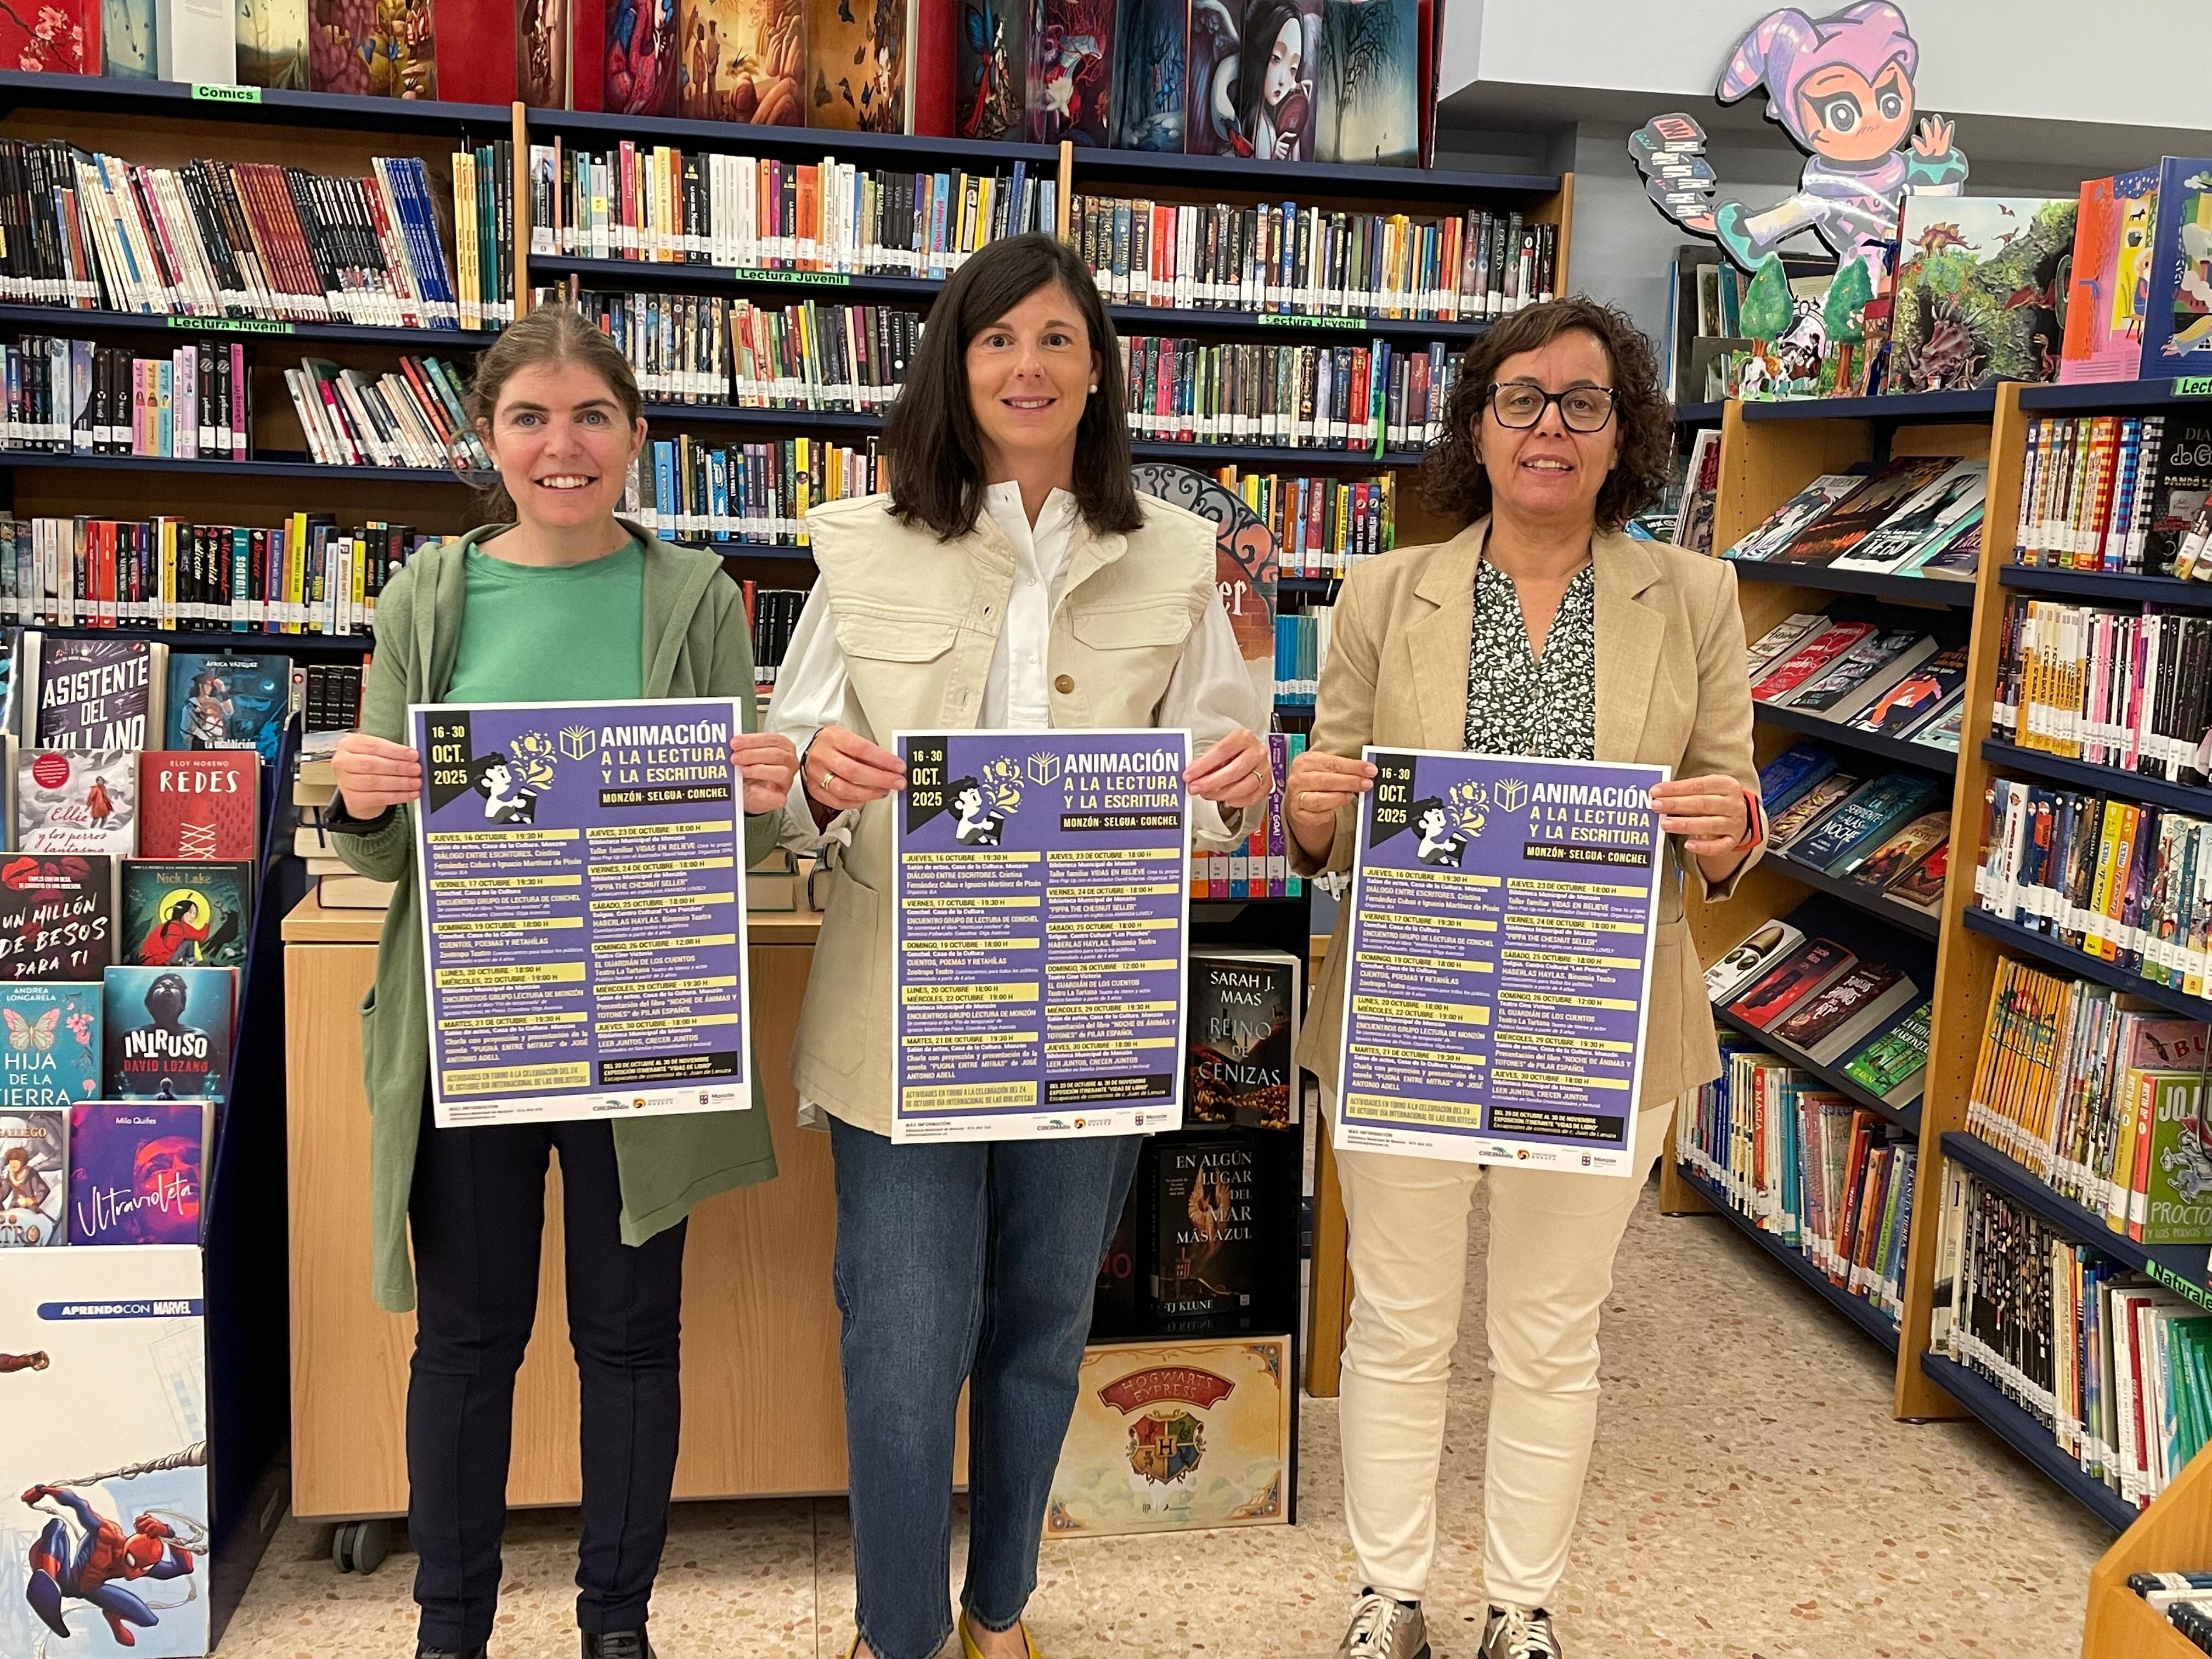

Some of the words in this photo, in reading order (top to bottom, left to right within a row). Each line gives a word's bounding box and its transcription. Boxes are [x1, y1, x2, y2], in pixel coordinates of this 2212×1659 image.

[199, 87, 253, 100] Comics
[741, 269, 792, 281] Lectura
[797, 273, 844, 284] Juvenil
[174, 318, 230, 329] Lectura
[234, 320, 286, 332] Juvenil
[42, 655, 148, 709] ASISTENTE
[81, 698, 108, 726] DEL
[600, 719, 727, 747] ANIMACIÓN
[432, 744, 465, 763] OCT.
[601, 751, 612, 765] A
[619, 750, 641, 765] LA
[648, 747, 725, 764] LECTURA
[1064, 748, 1179, 773] ANIMACIÓN
[160, 770, 240, 794] REDES
[434, 770, 467, 785] 2025
[601, 770, 612, 783] Y
[620, 769, 639, 783] LA
[647, 765, 728, 782] ESCRITURA
[913, 768, 941, 785] OCT.
[1064, 777, 1074, 791] A
[1080, 776, 1100, 791] LA
[1107, 776, 1178, 791] LECTURA
[687, 788, 729, 799] CONCHEL
[912, 792, 942, 806] 2025
[1064, 795, 1073, 809] Y
[1080, 795, 1097, 809] LA
[1104, 794, 1179, 808] ESCRITURA
[1379, 784, 1407, 803] OCT.
[1531, 782, 1652, 809] ANIMACIÓN
[51, 806, 88, 822] Ellie
[1141, 815, 1178, 826] CONCHEL
[1376, 808, 1407, 823] 2025
[1530, 805, 1541, 820] A
[1547, 806, 1567, 822] LA
[1574, 809, 1650, 827] LECTURA
[35, 833, 45, 849] y
[49, 828, 65, 839] los
[64, 832, 108, 847] perros
[1529, 824, 1539, 838] Y
[1545, 825, 1564, 839] LA
[1571, 827, 1649, 845] ESCRITURA
[1820, 820, 1860, 843] NOCHE
[1608, 851, 1647, 864] CONCHEL
[156, 872, 182, 884] Nick
[185, 873, 211, 884] Lake
[2093, 881, 2103, 912] diario
[2098, 868, 2106, 879] de
[2110, 883, 2120, 913] diario
[2115, 870, 2123, 882] de
[2, 906, 26, 929] UN
[32, 891, 97, 928] MILLÓN
[0, 935, 26, 959] DE
[33, 916, 108, 952] BESOS
[14, 956, 60, 980] PARA
[70, 950, 88, 967] TI
[1210, 971, 1259, 988] SARAH
[1264, 976, 1274, 992] J.
[1221, 990, 1262, 1006] MAAS
[1210, 1017, 1272, 1040] REINO
[125, 1029, 208, 1058] INTRUSO
[1232, 1045, 1249, 1058] DE
[5, 1053, 57, 1070] HIJA
[124, 1059, 159, 1072] DAVID
[163, 1060, 208, 1073] LOZANO
[9, 1074, 28, 1085] DE
[33, 1074, 52, 1085] LA
[1199, 1061, 1280, 1087] CENIZAS
[0, 1088, 71, 1106] IERRA
[1176, 1155, 1196, 1168] EN
[1201, 1150, 1251, 1166] ALGÚN
[1203, 1170, 1252, 1185] LUGAR
[1231, 1189, 1251, 1200] DEL
[77, 1171, 191, 1237] Ultravioleta
[1209, 1206, 1252, 1222] MAR
[1176, 1228, 1209, 1244] MÁS
[1214, 1227, 1252, 1241] AZUL
[153, 1301, 191, 1314] MARVEL
[1179, 1300, 1213, 1311] KLUNE
[1121, 1372, 1213, 1392] HOGWARTS
[1133, 1384, 1197, 1402] EXPRESS
[1159, 1438, 1173, 1455] H
